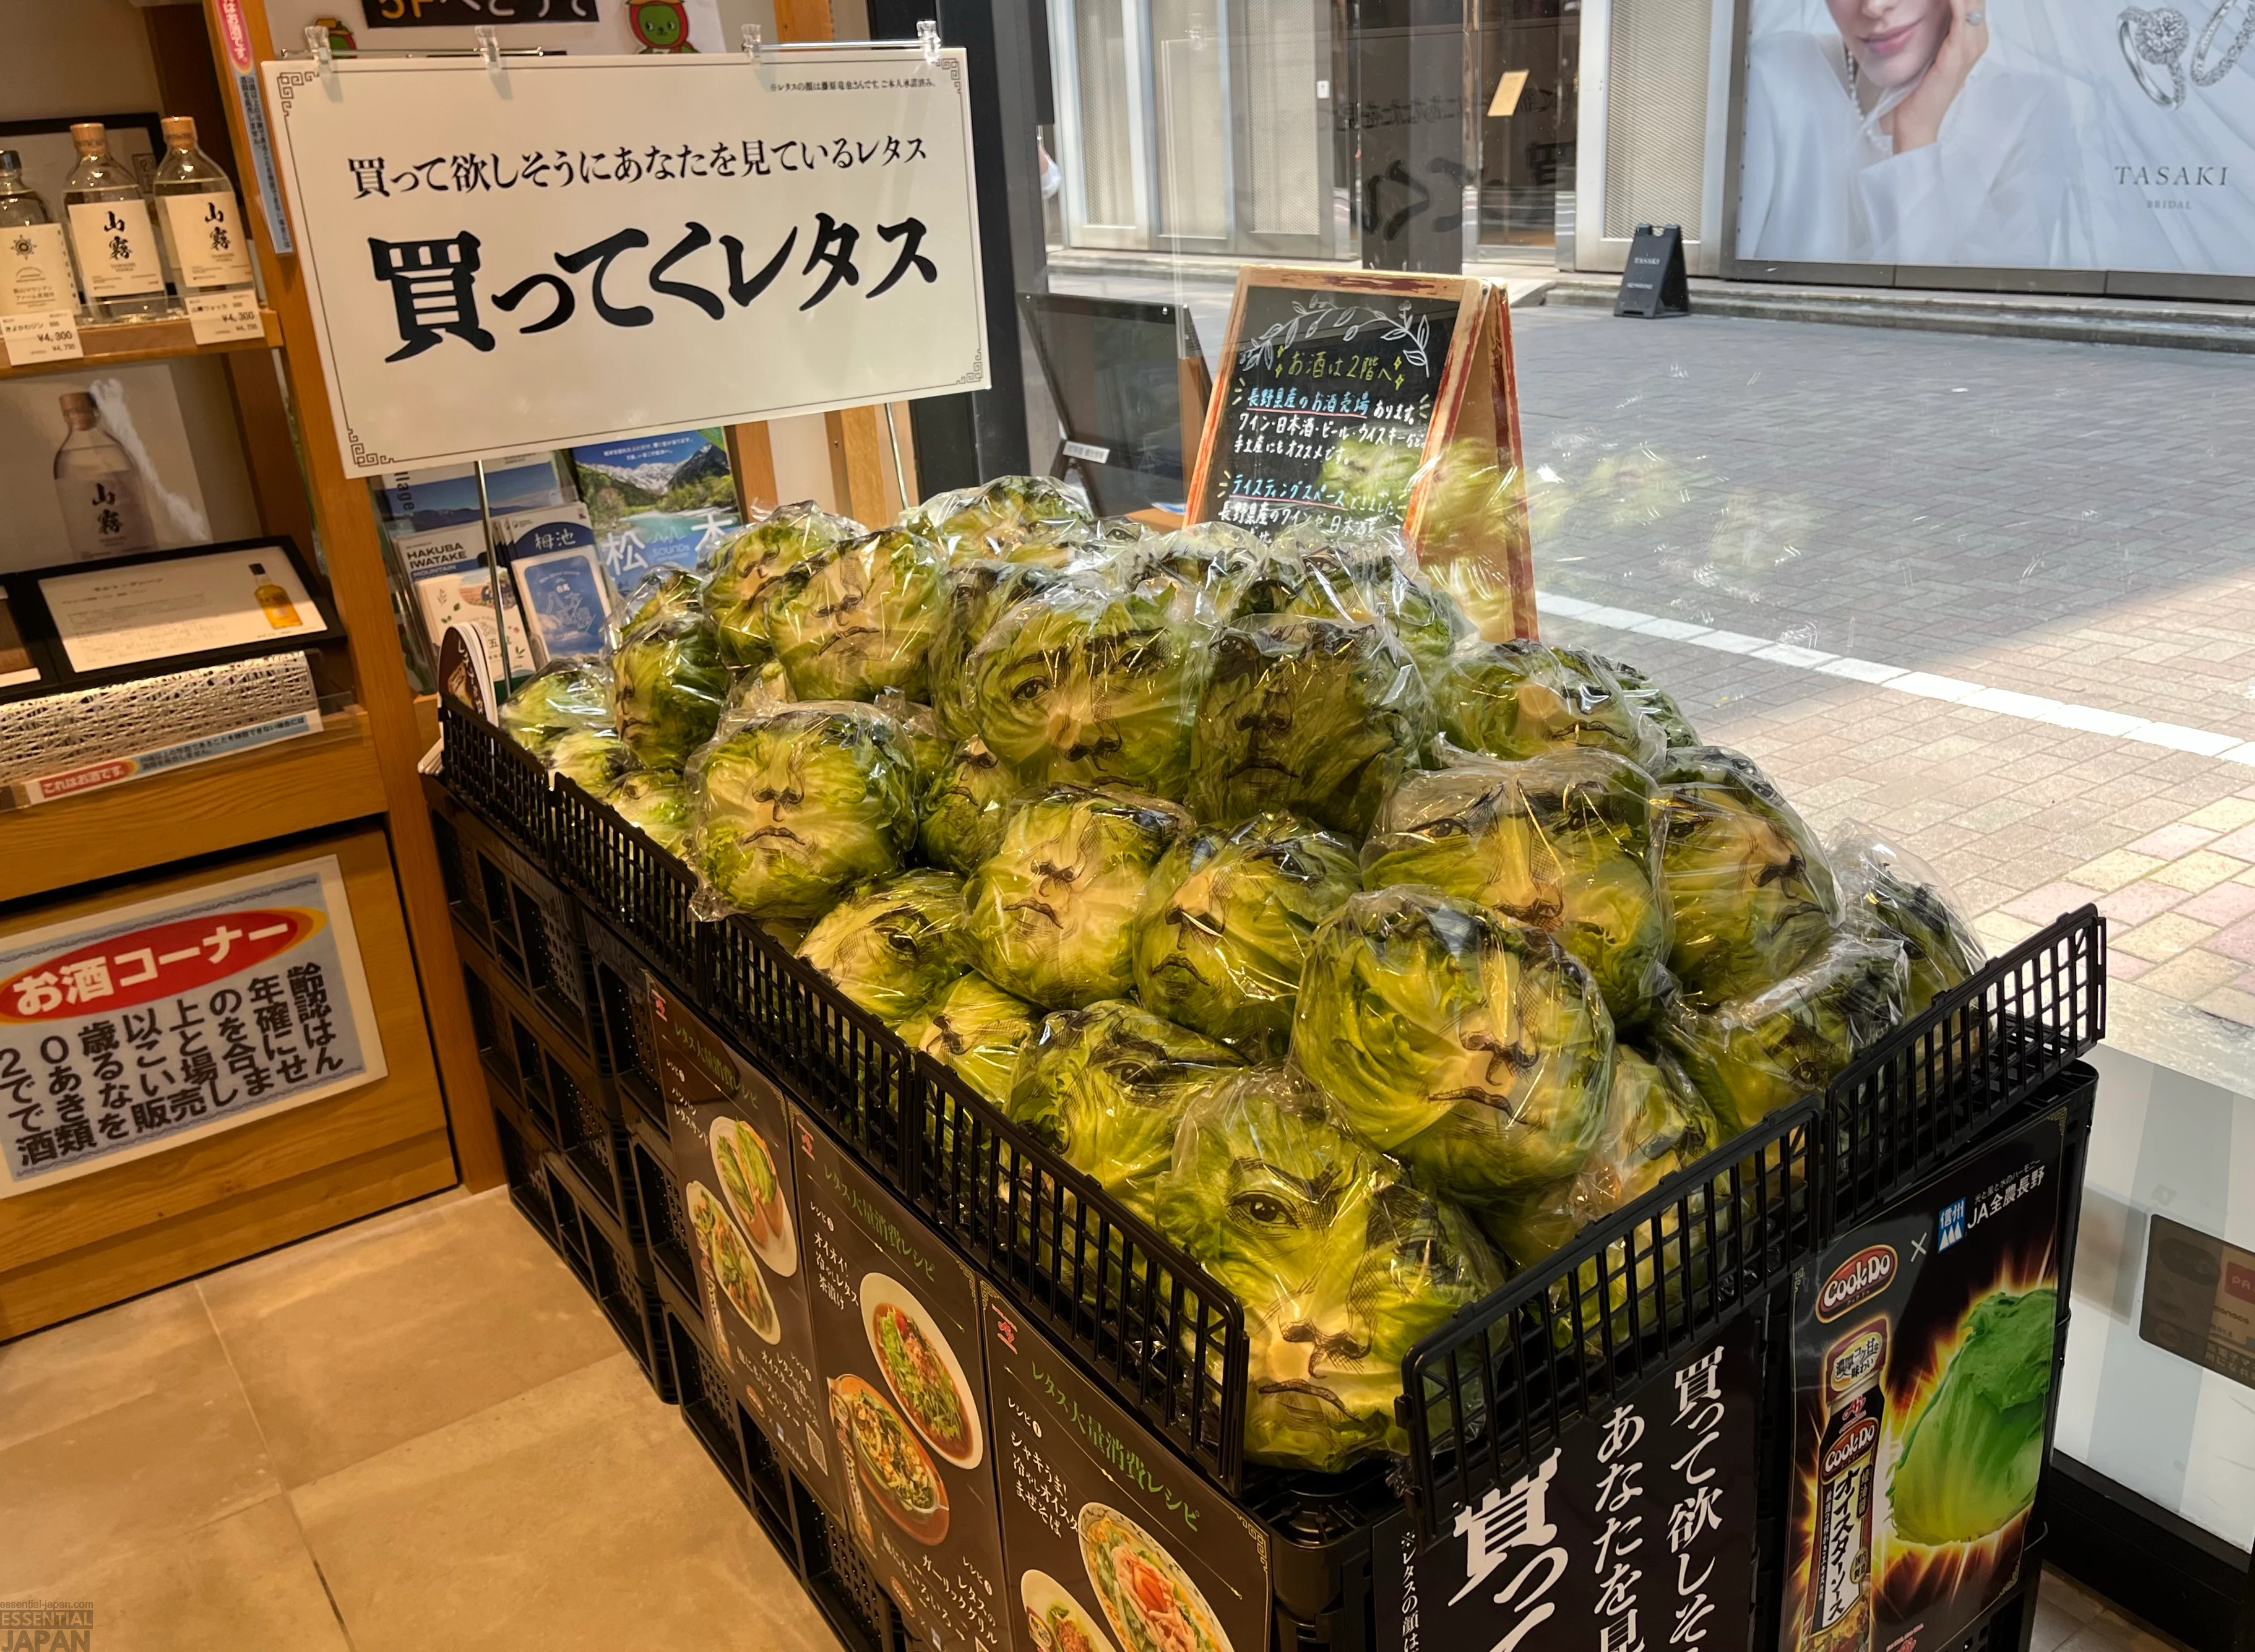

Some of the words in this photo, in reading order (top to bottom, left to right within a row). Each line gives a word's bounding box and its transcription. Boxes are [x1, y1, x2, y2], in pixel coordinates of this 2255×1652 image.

[348, 135, 928, 200] 買って欲しそうにあなたを見ているレタス
[2114, 165, 2229, 186] TASAKI
[2147, 199, 2192, 210] BRIDAL
[368, 212, 938, 363] 買ってくレタス
[1288, 351, 1392, 382] お酒は2階へ
[406, 542, 464, 560] HAKUBA
[410, 551, 467, 569] IWATAKE
[413, 564, 457, 577] MOUNTAIN
[13, 923, 289, 1016] お酒コーナー
[0, 988, 332, 1104] であることを確認
[8, 1020, 335, 1132] できない場合には
[16, 1046, 343, 1167] 酒類を販売しません
[1940, 1200, 1965, 1229] 信州
[1967, 1165, 2045, 1229] JA全農長野
[1032, 1361, 1200, 1532] レタス大量消費レシピ
[1015, 1480, 1062, 1538] まぜそば
[1666, 1345, 1725, 1652] 買って欲しそ
[1827, 1467, 1861, 1621] オイスターソース
[1401, 1529, 1419, 1652] ※レタスの顔は
